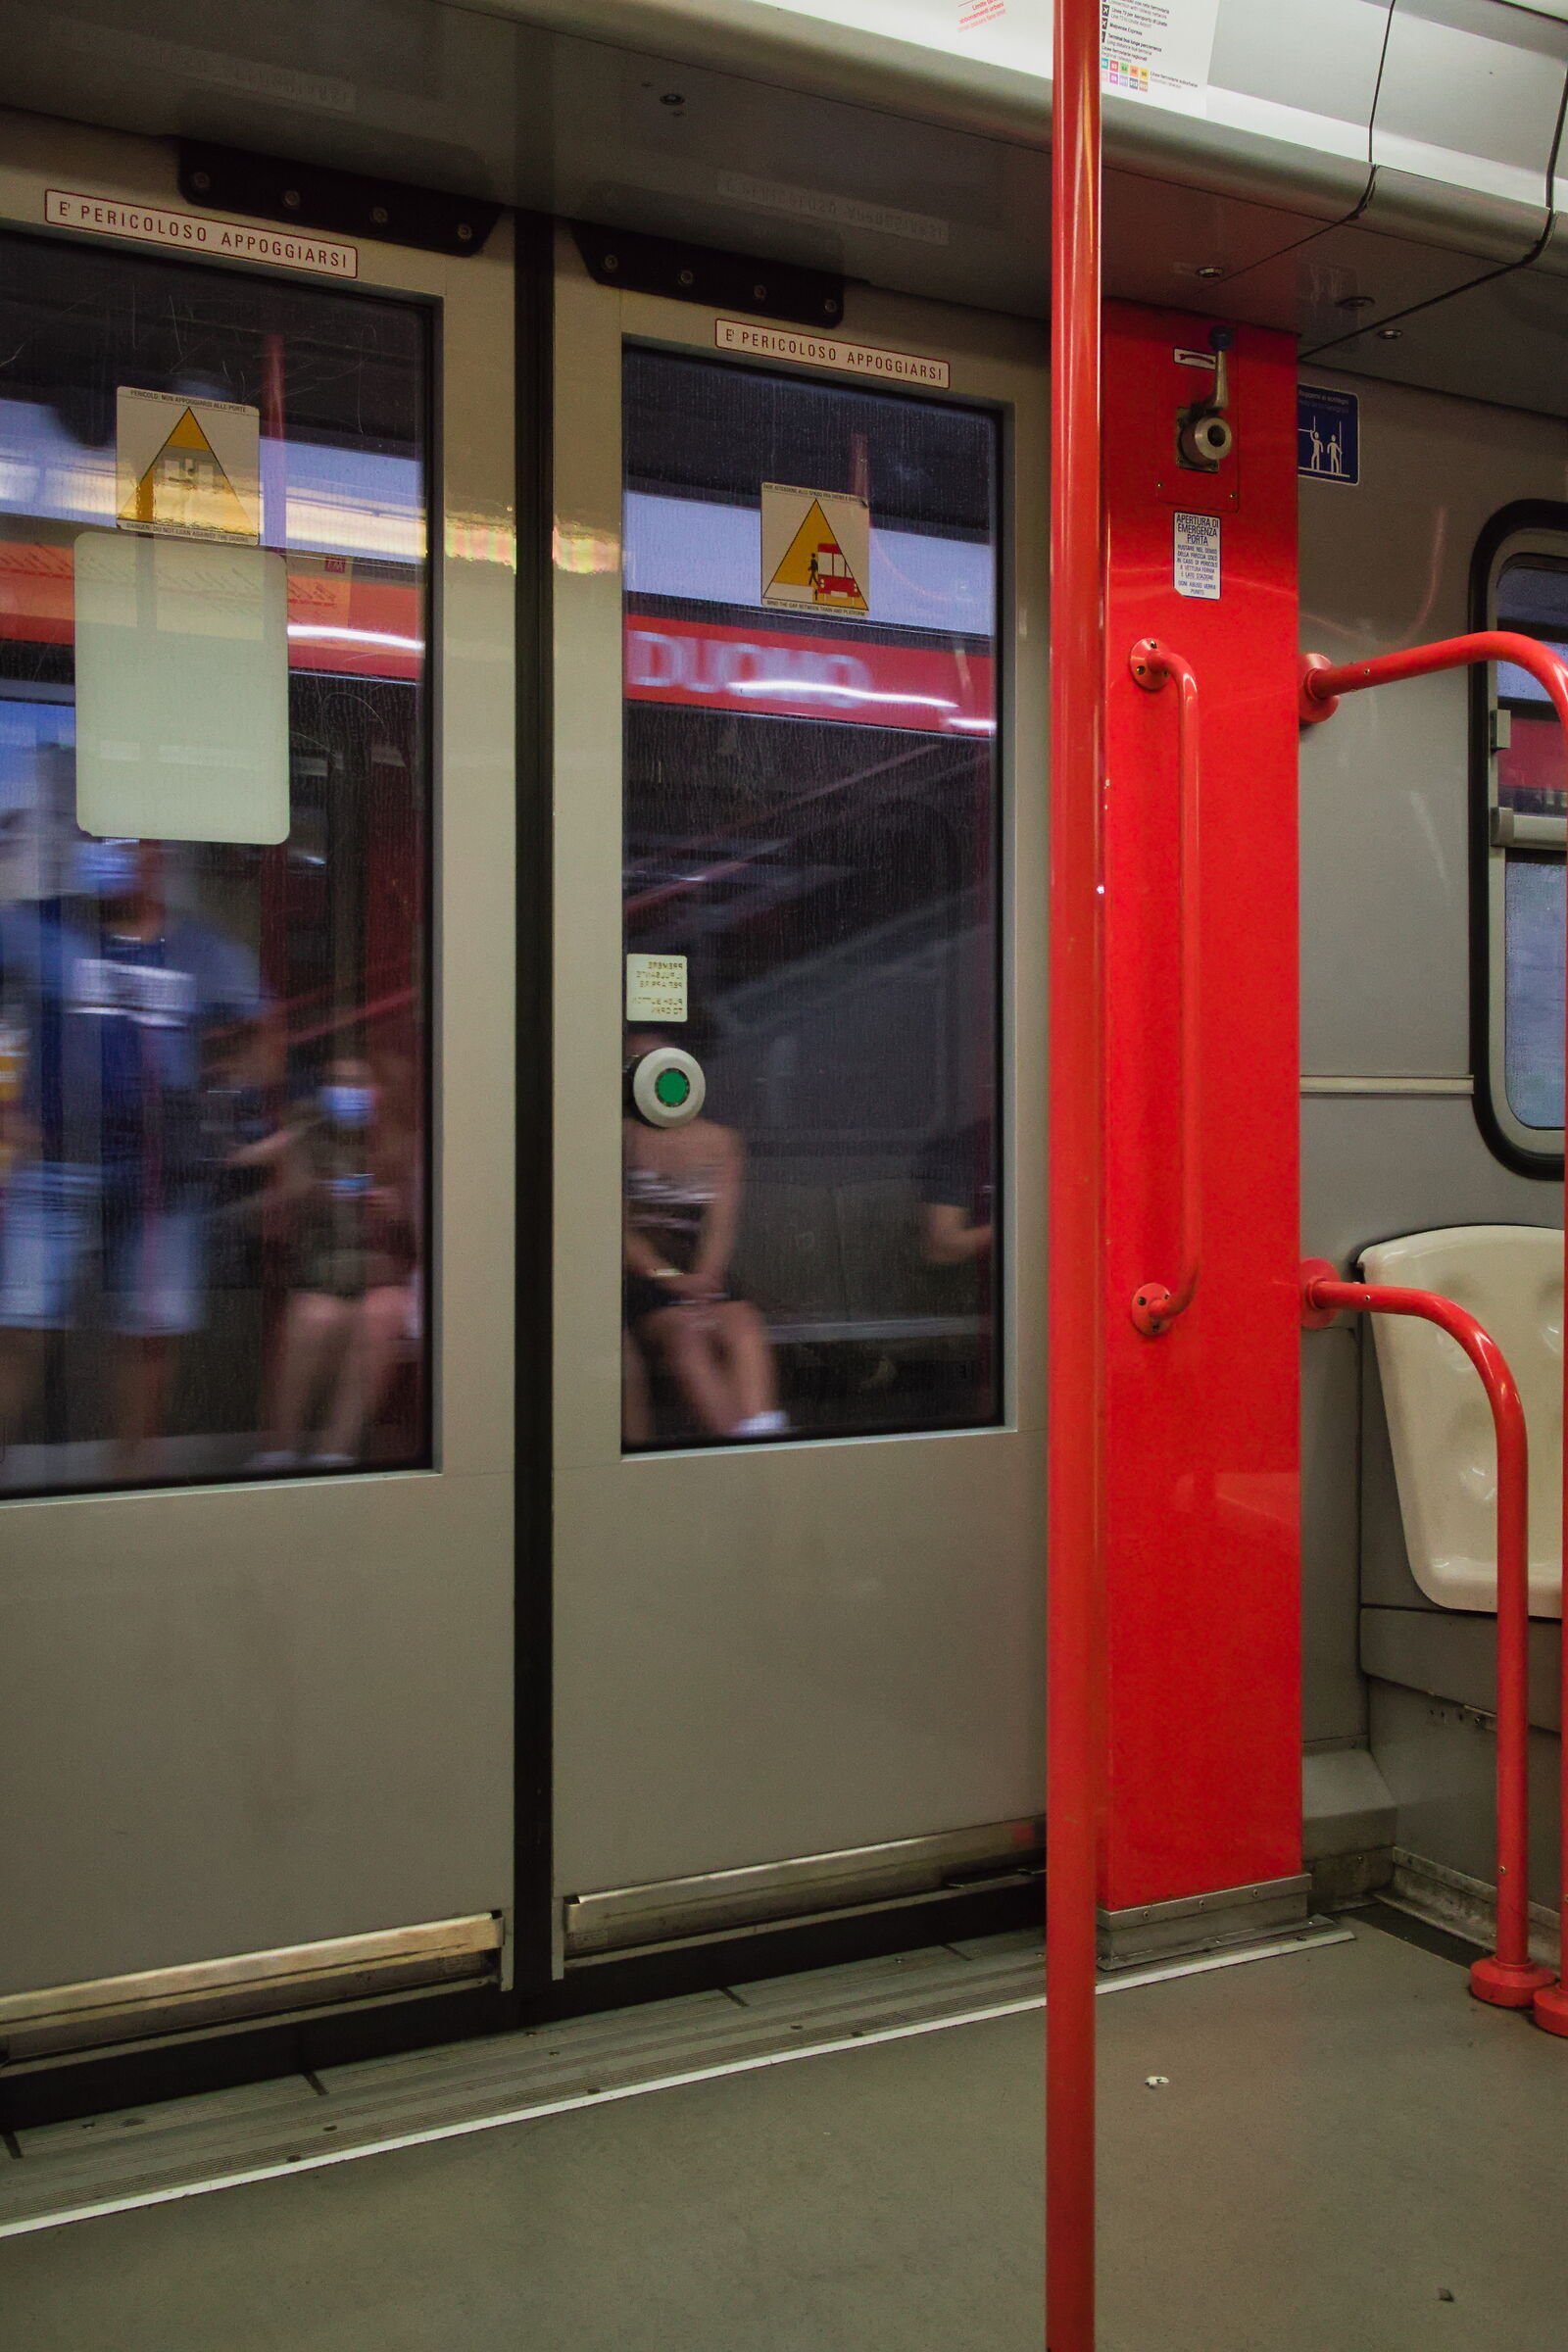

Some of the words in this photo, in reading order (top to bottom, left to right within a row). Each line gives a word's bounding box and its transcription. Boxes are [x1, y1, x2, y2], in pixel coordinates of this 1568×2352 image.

[80, 205, 207, 242] PERICOLOSO
[220, 231, 347, 269] APPOGGIARSI
[742, 331, 836, 361] PERICOLOSO
[847, 351, 942, 380] APPOGGIARSI
[1177, 514, 1210, 526] APERTURA
[1212, 519, 1219, 528] DI
[1178, 523, 1217, 538] EMERGENZA
[1188, 534, 1208, 546] PORTA
